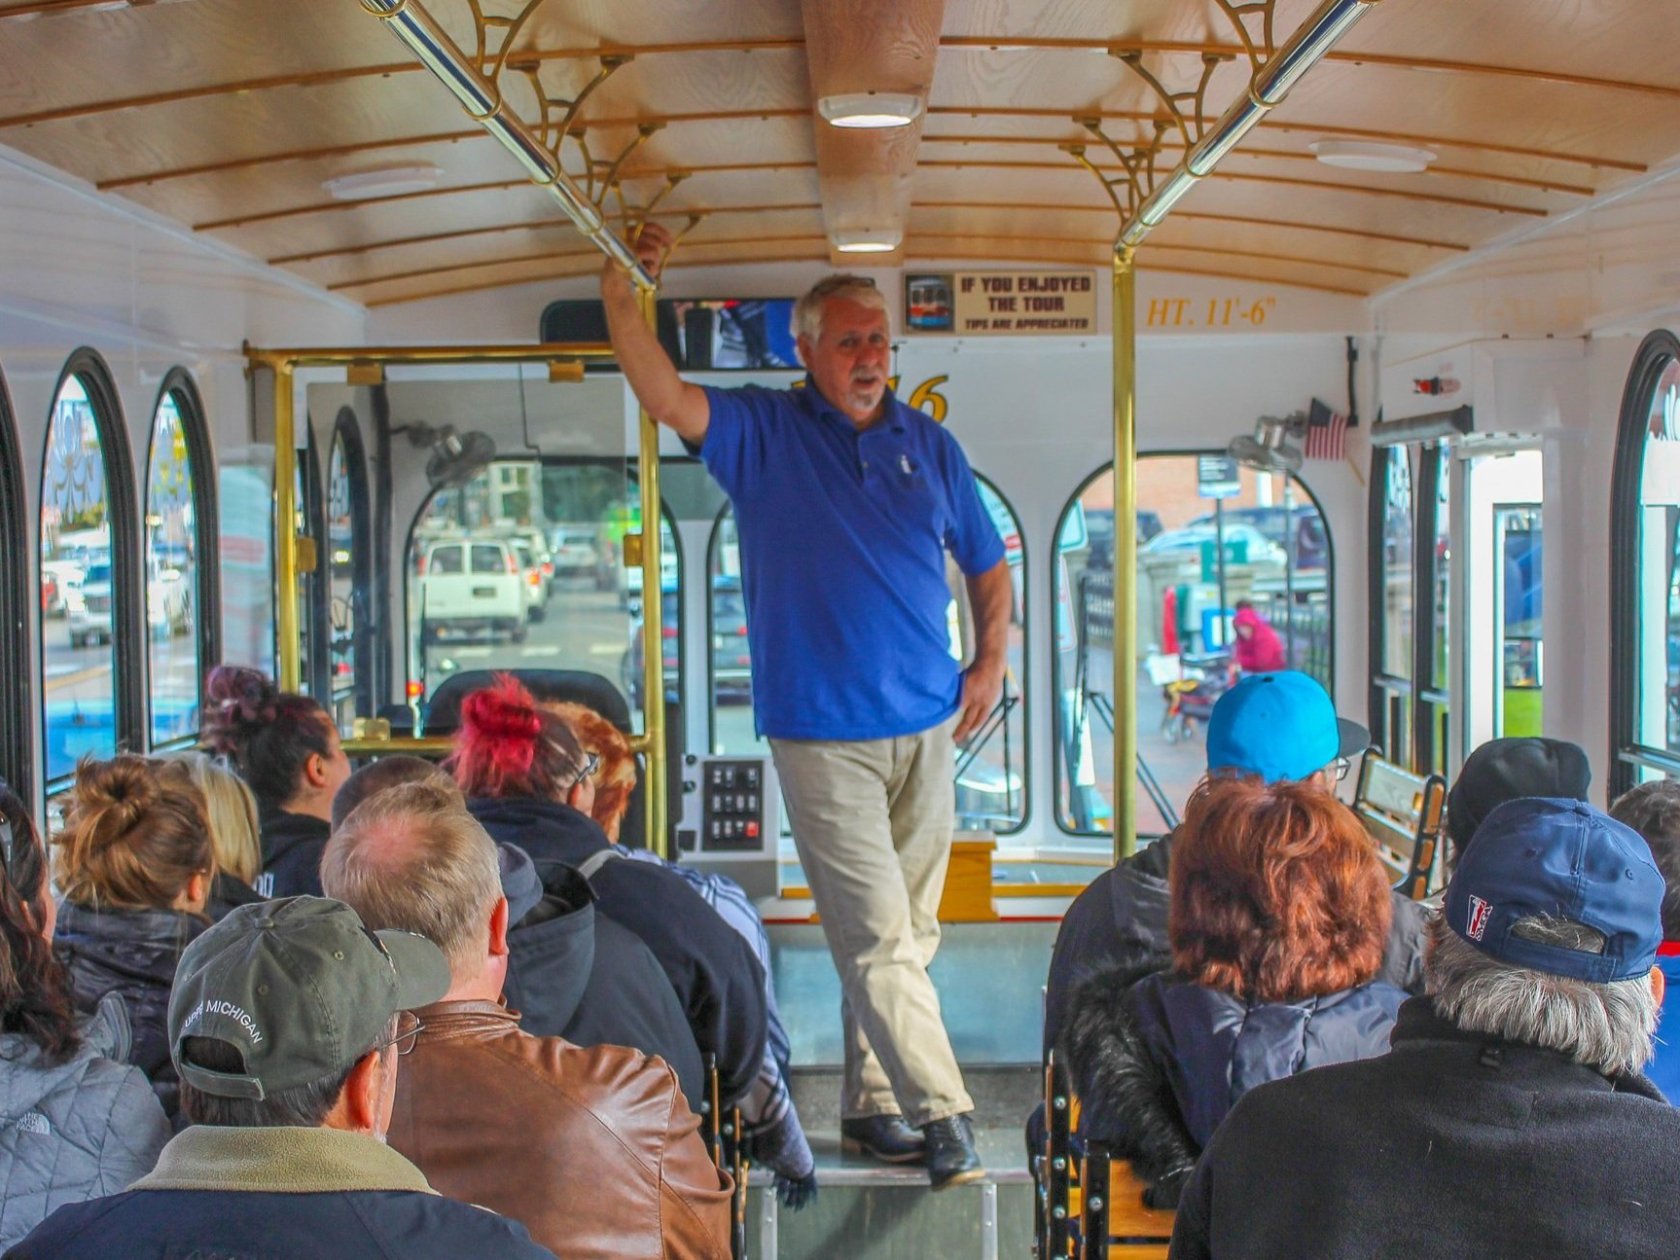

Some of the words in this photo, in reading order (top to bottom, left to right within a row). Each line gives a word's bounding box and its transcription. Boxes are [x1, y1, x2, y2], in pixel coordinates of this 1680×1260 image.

[961, 277, 976, 293] IF
[981, 277, 1013, 293] YOU
[1018, 277, 1090, 293] ENJOYED
[988, 297, 1017, 312] THE
[1023, 297, 1064, 312] TOUR
[1147, 298, 1194, 326] HT.
[965, 319, 988, 330] TIPS
[992, 319, 1011, 330] ARE
[1016, 318, 1089, 330] APPRECIATED
[205, 1000, 263, 1044] MICHIGAN
